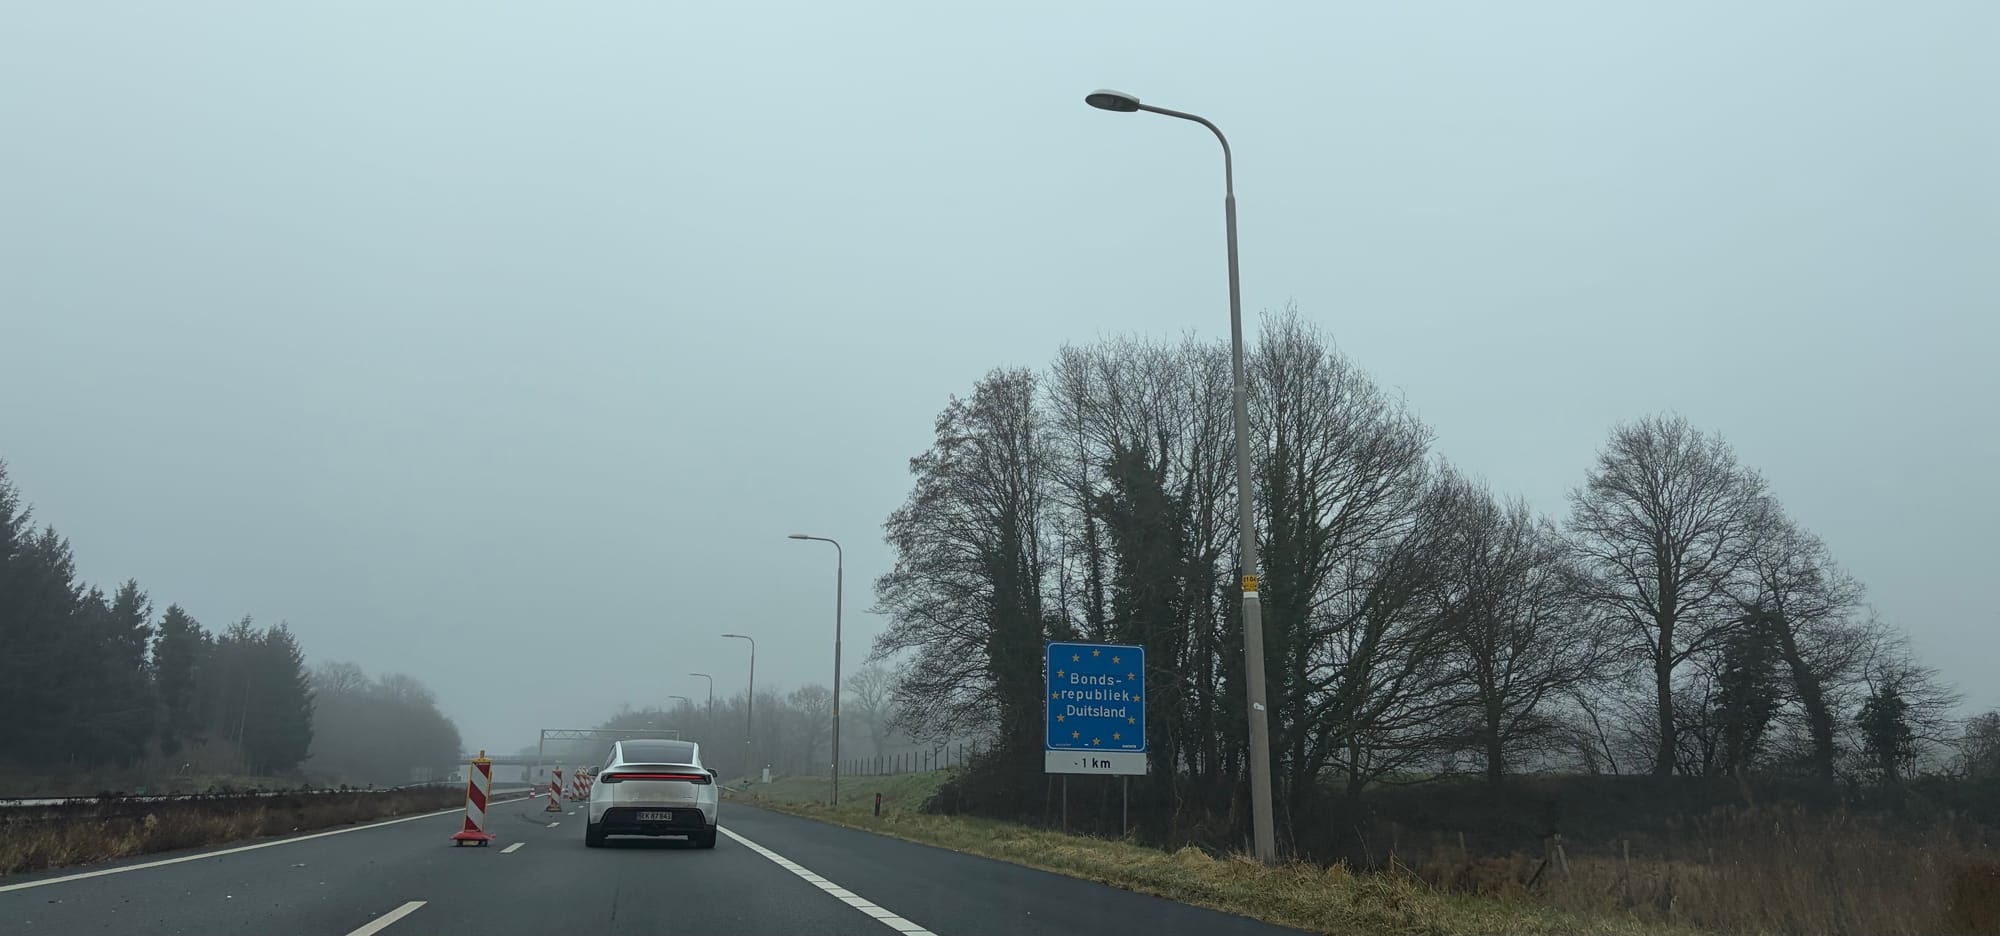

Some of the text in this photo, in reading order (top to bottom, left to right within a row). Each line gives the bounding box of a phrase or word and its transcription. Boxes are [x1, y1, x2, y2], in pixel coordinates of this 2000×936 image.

[1070, 672, 1122, 685] Bonds-
[1061, 689, 1129, 701] republiek
[1066, 704, 1126, 718] Duitsland
[1082, 757, 1111, 768] 1 km
